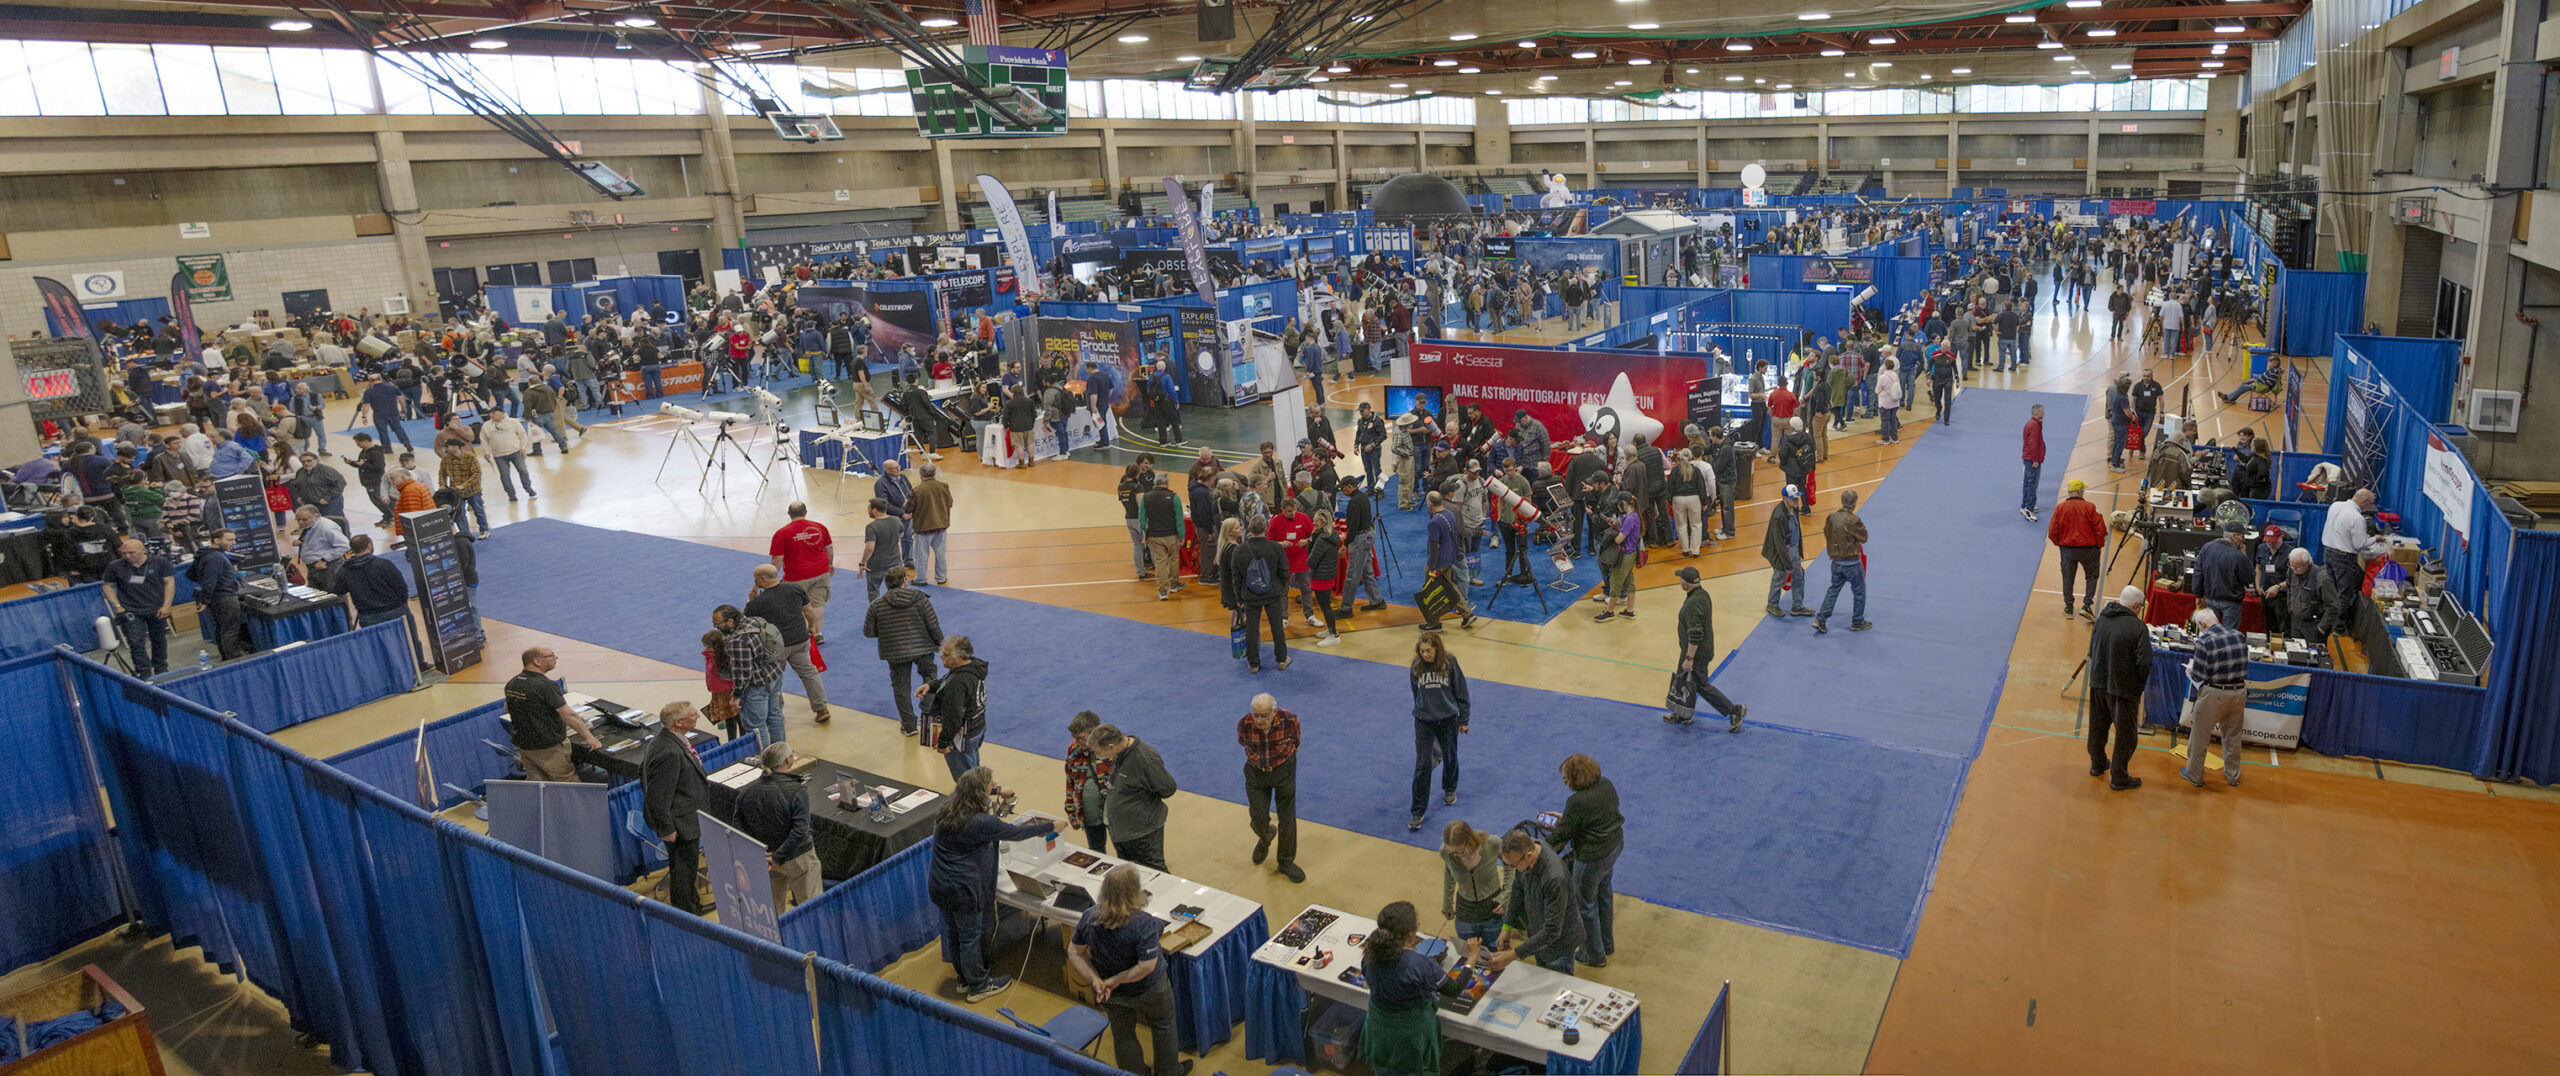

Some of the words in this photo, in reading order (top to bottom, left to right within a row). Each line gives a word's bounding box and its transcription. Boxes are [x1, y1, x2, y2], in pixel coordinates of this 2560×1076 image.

[1000, 55, 1030, 65] Provident
[1031, 57, 1048, 65] Bank
[870, 239, 890, 248] Tele
[892, 237, 911, 246] Vue
[927, 234, 946, 243] Tele
[948, 232, 966, 241] Vue
[809, 243, 831, 254] Tele
[833, 241, 853, 251] Vue
[1567, 252, 1604, 261] Sky-Watcher
[949, 275, 986, 288] TELESCOPE
[879, 303, 912, 311] CELESTRON
[1181, 312, 1215, 320] EXPLORE
[1080, 331, 1094, 340] ALL
[1095, 329, 1116, 340] New
[1045, 338, 1079, 351] 2026
[1081, 341, 1119, 353] Product
[1082, 353, 1120, 364] Launch
[1465, 354, 1504, 368] Seestar
[29, 373, 72, 398] EXIT
[1453, 383, 1479, 398] MAKE
[1581, 392, 1607, 407] EASY
[1634, 395, 1654, 410] FUN
